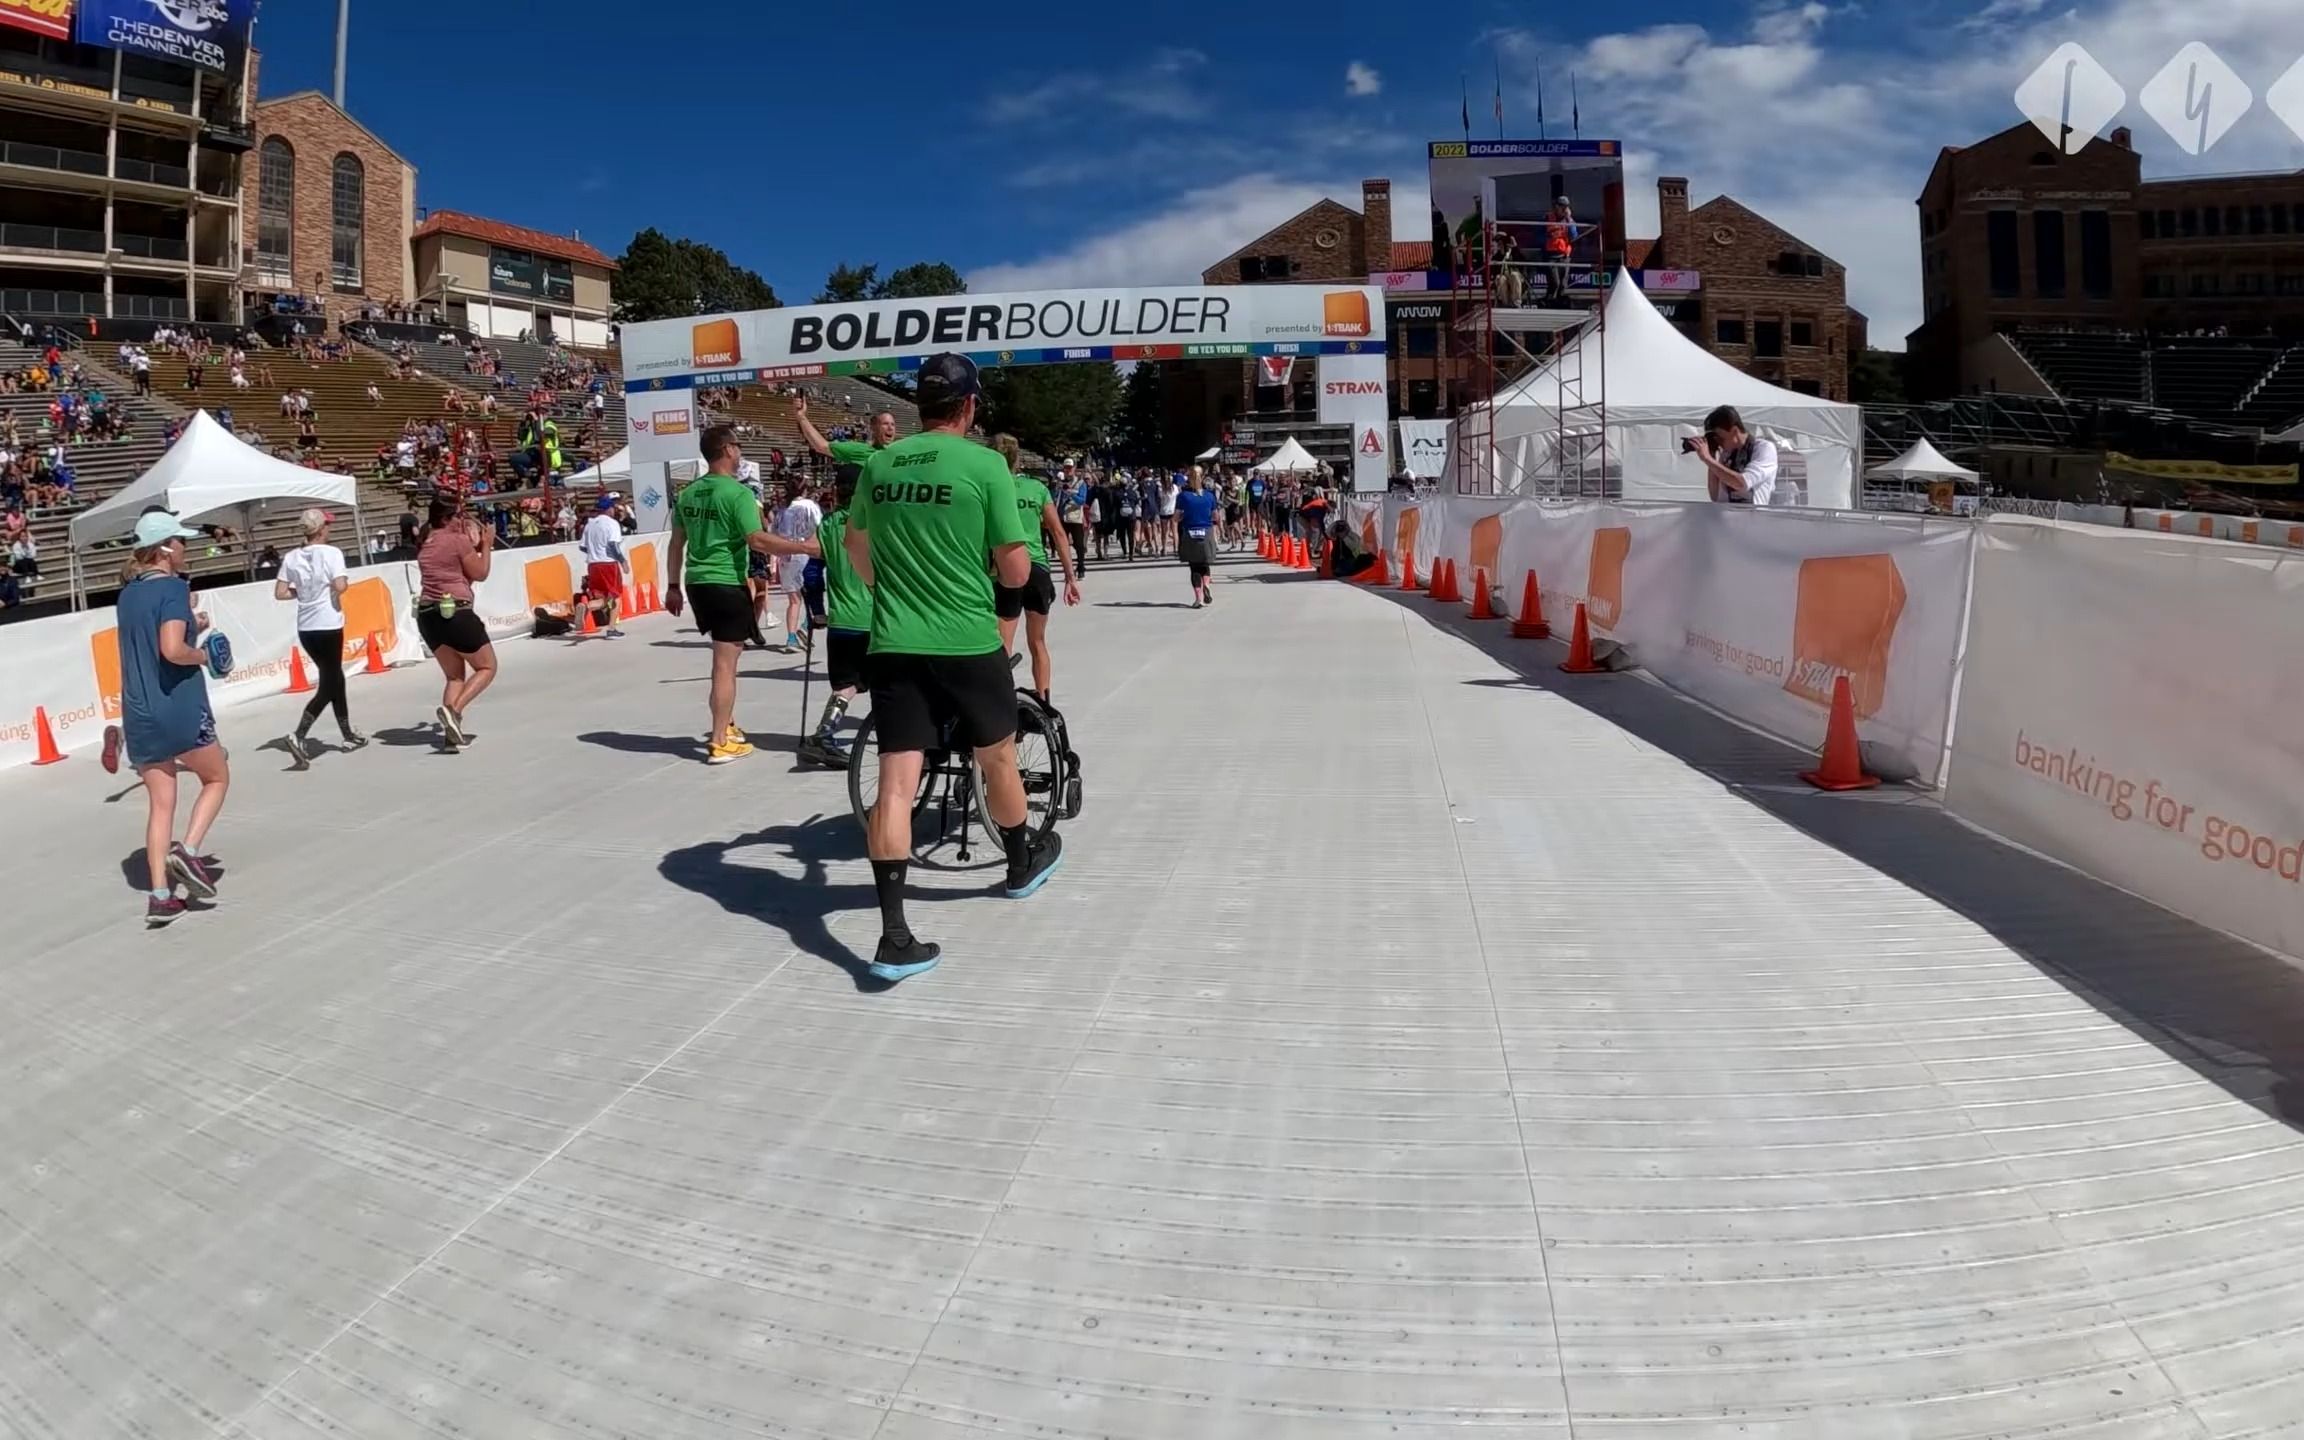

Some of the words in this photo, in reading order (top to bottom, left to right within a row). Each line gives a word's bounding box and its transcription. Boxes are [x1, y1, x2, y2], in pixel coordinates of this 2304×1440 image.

[108, 29, 226, 71] CHANNEL.COM
[1436, 144, 1465, 156] 2022
[1265, 324, 1311, 335] presented
[1312, 324, 1323, 334] by
[1064, 348, 1091, 359] FINISH
[1273, 343, 1299, 353] FINISH
[636, 357, 680, 371] presented
[681, 357, 691, 369] by
[1326, 381, 1383, 394] STRAVA
[655, 411, 687, 423] KING
[872, 482, 953, 506] GUIDE
[683, 506, 720, 521] GUIDE
[1745, 653, 1785, 678] good
[59, 701, 96, 730] good
[2015, 728, 2137, 822] banking
[2144, 778, 2195, 833] for
[2201, 815, 2304, 883] good
